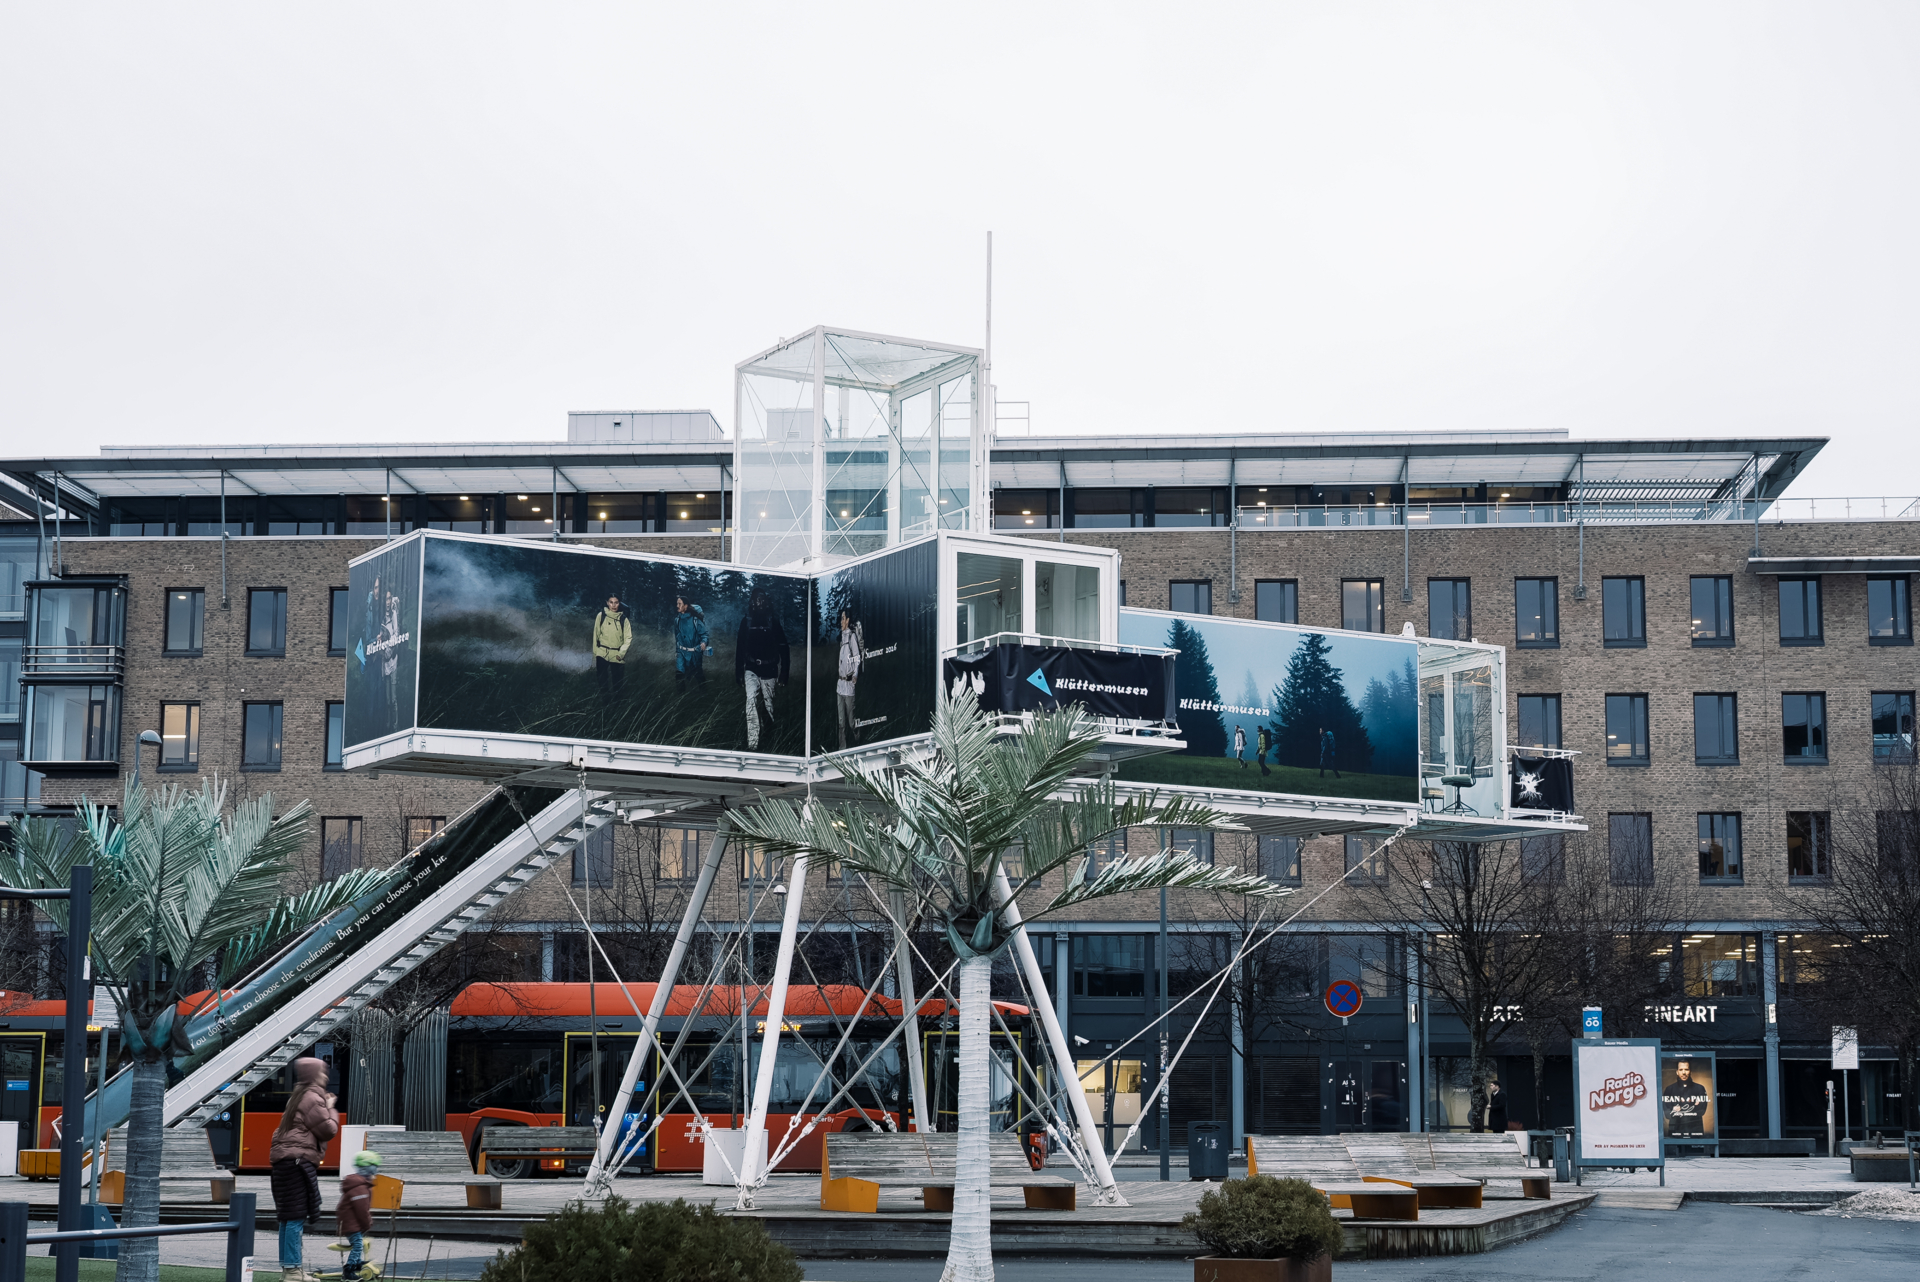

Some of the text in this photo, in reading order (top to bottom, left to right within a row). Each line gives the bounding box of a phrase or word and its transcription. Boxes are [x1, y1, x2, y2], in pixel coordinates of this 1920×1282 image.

[865, 648, 884, 659] Summer
[1055, 678, 1149, 696] Klättermusen
[1179, 698, 1270, 716] Klättermusen
[228, 1009, 241, 1025] get
[242, 1001, 253, 1011] to
[254, 981, 281, 1003] choose
[280, 970, 296, 983] the
[296, 941, 336, 972] conditions.
[335, 925, 354, 941] But
[354, 912, 371, 932] you
[371, 902, 386, 915] can
[386, 880, 413, 904] choose
[413, 866, 432, 887] your
[430, 854, 448, 868] kit.
[1606, 1073, 1642, 1092] Radio
[1590, 1084, 1645, 1109] Norge
[1690, 1095, 1711, 1103] PAUL
